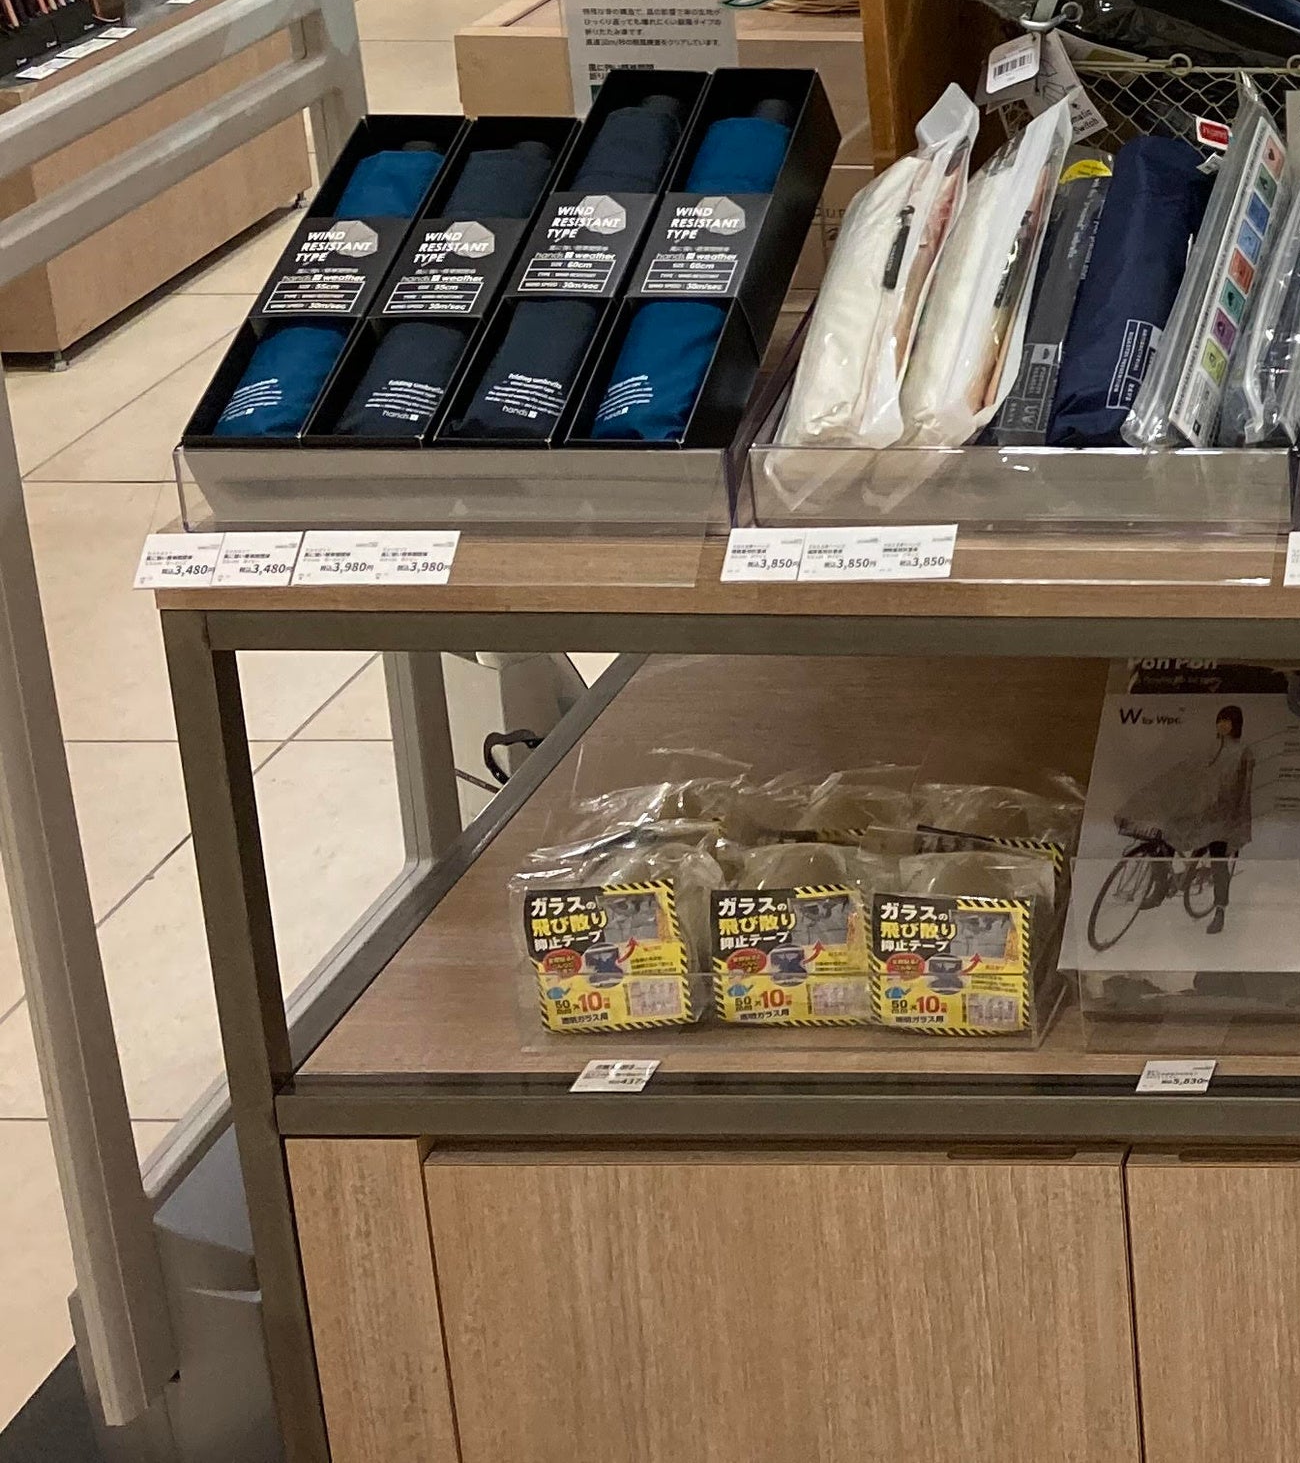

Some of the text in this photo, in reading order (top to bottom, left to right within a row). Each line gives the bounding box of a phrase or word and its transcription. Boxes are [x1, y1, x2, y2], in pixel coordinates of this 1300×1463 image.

[307, 232, 345, 241] WIND
[425, 232, 463, 242] WIND
[301, 241, 372, 252] RESISTANT
[419, 242, 489, 253] RESISTANT
[295, 253, 328, 263] TYPE
[414, 253, 445, 263] TYPE
[531, 896, 597, 917] ガラスの
[531, 910, 607, 936] 飛び散り
